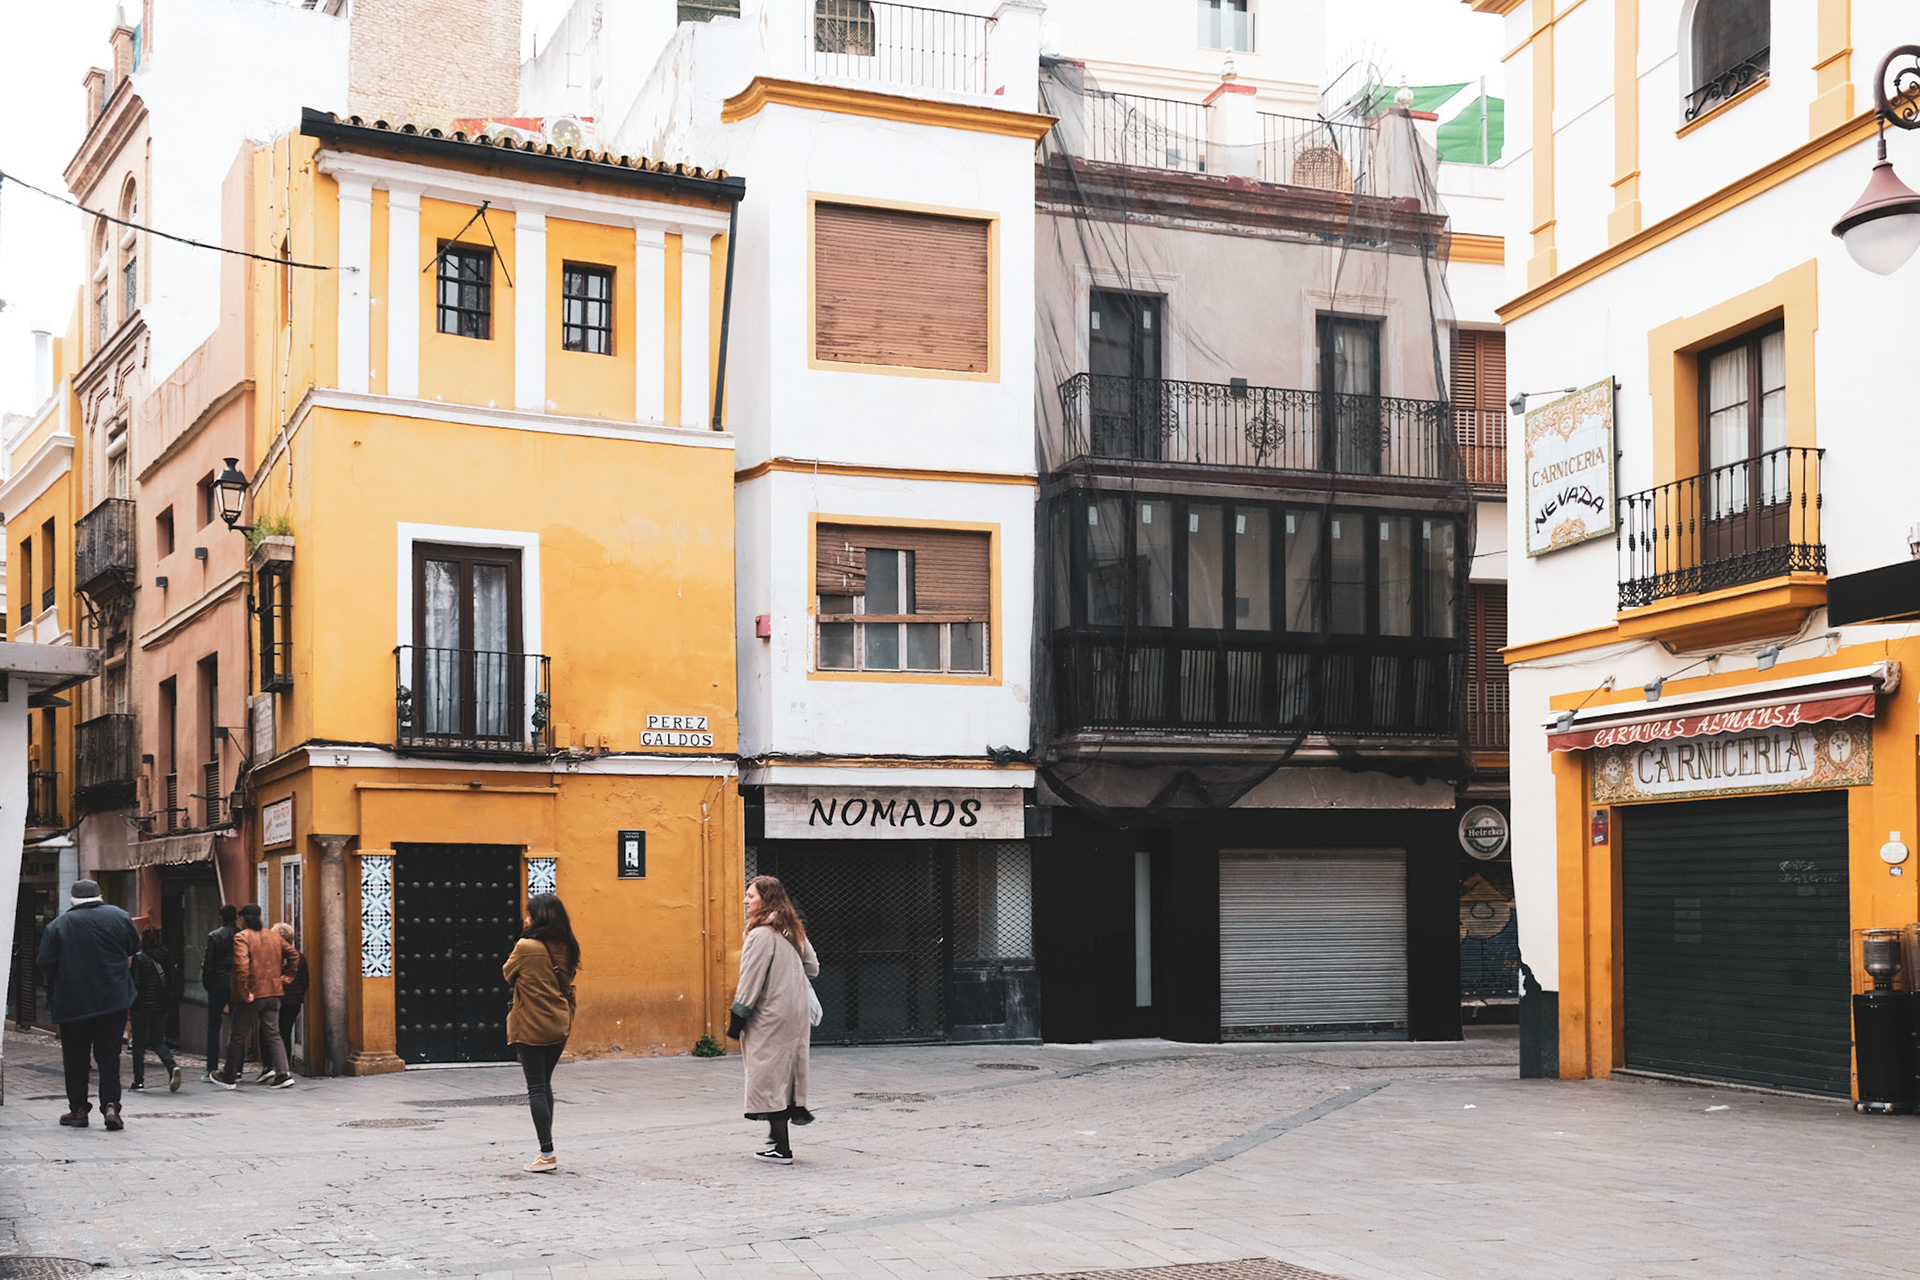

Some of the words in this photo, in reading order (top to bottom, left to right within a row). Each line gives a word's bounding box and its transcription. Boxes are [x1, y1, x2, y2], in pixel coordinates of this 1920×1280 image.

[1535, 484, 1605, 533] NEVADA
[648, 715, 706, 730] PEREZ
[1594, 718, 1686, 745] CARNICAS
[1695, 703, 1802, 733] ALMANSA
[642, 732, 712, 747] GALDOS
[809, 797, 982, 828] NOMADS
[1468, 827, 1504, 837] Heineken
